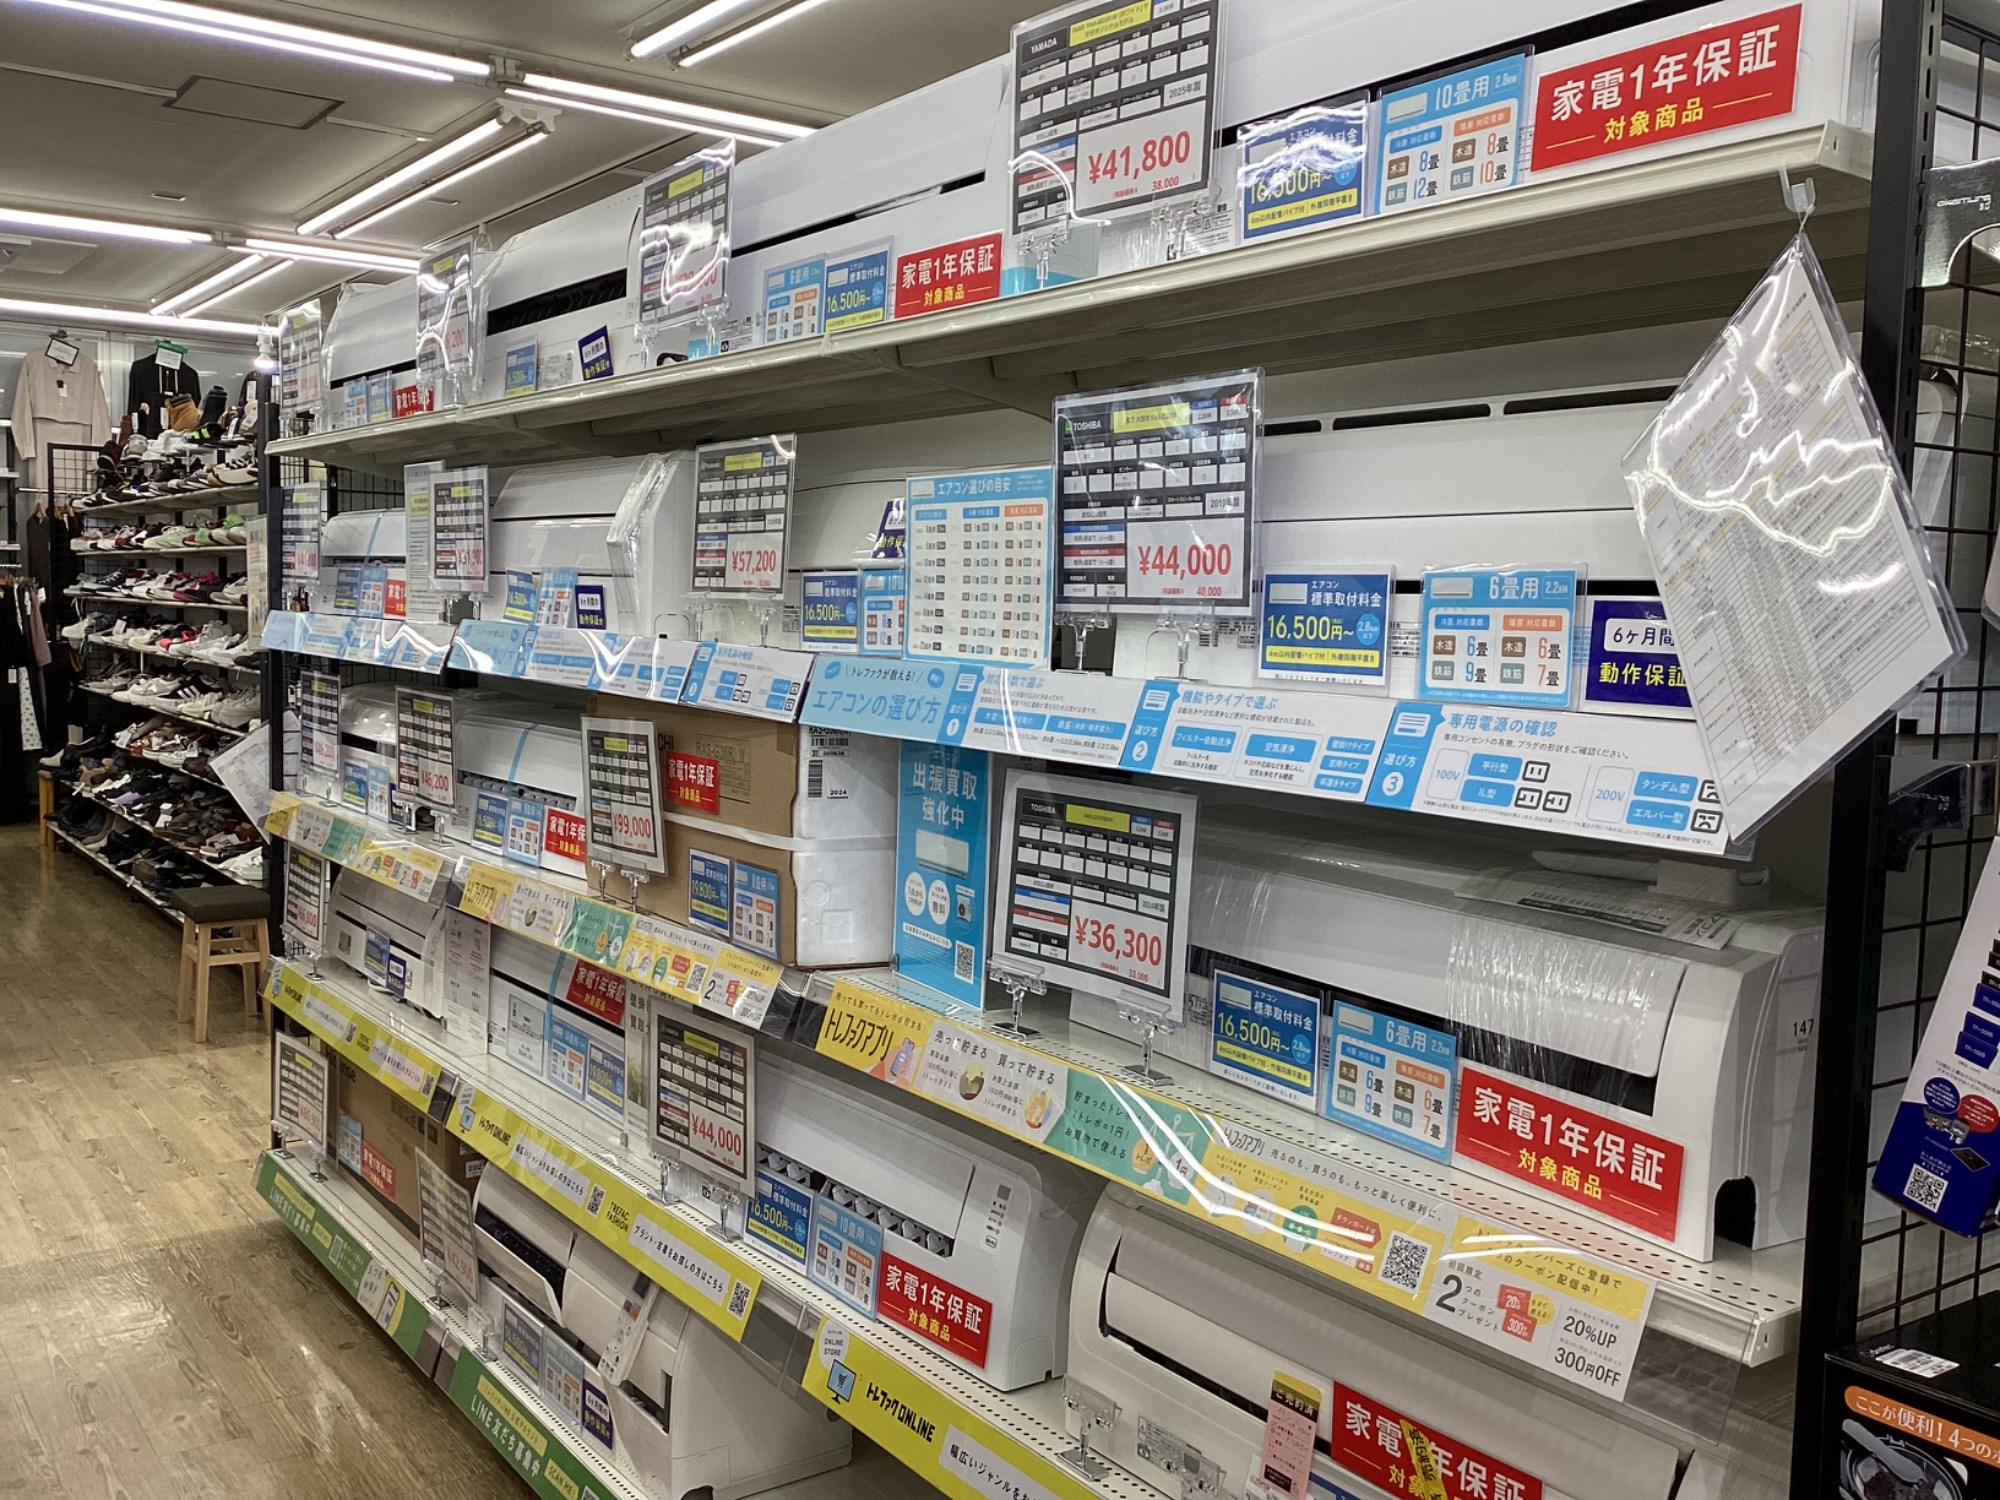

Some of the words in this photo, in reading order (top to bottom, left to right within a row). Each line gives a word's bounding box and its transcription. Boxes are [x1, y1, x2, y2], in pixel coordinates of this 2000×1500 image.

[1031, 37, 1057, 54] YAMADA
[1551, 24, 1781, 121] 家電1年保証
[1435, 75, 1490, 111] 10畳用
[1603, 97, 1704, 143] 対象商品
[1088, 131, 1191, 184] ¥41,800
[1454, 144, 1474, 159] 木造
[1486, 133, 1509, 155] 8畳
[1419, 151, 1440, 172] 8畳
[1479, 160, 1507, 184] 10畳
[1152, 176, 1180, 191] 38,000
[1413, 177, 1438, 200] 12畳
[902, 243, 995, 289] 家電1年保証
[923, 284, 965, 307] 対象商品
[1073, 420, 1102, 432] TOSHIBA
[937, 477, 1012, 496] エアコン選びの目安
[732, 550, 777, 575] ¥57,200
[1138, 543, 1232, 580] ¥44,000
[1311, 580, 1340, 589] エアコン
[1489, 576, 1539, 600] 6畳用
[1311, 592, 1381, 607] 標準取付料金
[1434, 639, 1454, 652] 木造
[1467, 635, 1488, 657] 6畳
[1503, 640, 1524, 654] 木造
[1538, 636, 1561, 659] 6畳
[986, 674, 1045, 688] 対応数で選ぶ
[1434, 664, 1453, 677] 鉄筋
[1466, 662, 1487, 683] 9畳
[1502, 667, 1523, 680] 鉄筋
[1538, 664, 1560, 687] 7畳
[1600, 662, 1687, 687] 動作保証
[812, 690, 942, 724] エアコンの選び方
[949, 704, 968, 715] 選び方
[1181, 690, 1278, 710] 機能やタイプで選ぶ
[1133, 725, 1158, 737] 選び方
[1448, 713, 1558, 737] 専用電源の確認
[1383, 753, 1418, 768] 選び方
[1481, 761, 1509, 774] 平行型
[668, 759, 715, 788] 家電1年保証
[913, 762, 977, 801] 出張買取
[1435, 768, 1461, 782] 100V
[1595, 788, 1625, 802] 200V
[1641, 778, 1691, 795] タンデム型
[922, 797, 965, 830] 強化中
[1030, 803, 1056, 814] TOSHIBA
[1632, 807, 1684, 824] エルバー型
[613, 813, 651, 838] ¥99,000
[1075, 915, 1162, 966] ¥36,300
[576, 967, 626, 1003] 家電1年保証
[704, 979, 716, 1000] 2
[1254, 991, 1278, 1003] エアコン
[1254, 1001, 1313, 1031] 標準取付料金
[1793, 1018, 1815, 1036] 147
[824, 1008, 894, 1062] トレファックアプリ
[1386, 1019, 1427, 1052] 6畳用
[997, 1053, 1055, 1085] 買って貯まる
[1340, 1065, 1357, 1080] 木造
[1366, 1070, 1384, 1094] 6畳
[1365, 1094, 1382, 1118] 9畳
[1396, 1085, 1413, 1101] 木造
[1424, 1090, 1443, 1115] 6畳
[691, 1113, 741, 1157] ¥44,000
[1423, 1115, 1441, 1140] 7畳
[1473, 1086, 1666, 1191] 家電1年保証
[467, 1162, 482, 1172] 202
[1518, 1148, 1602, 1200] 対象商品
[606, 1211, 630, 1233] FASHION
[610, 1201, 629, 1221] TREFAC
[1448, 1260, 1483, 1280] 初回限定
[886, 1265, 983, 1335] 家電1年保証
[1436, 1275, 1462, 1314] 2
[1465, 1285, 1481, 1297] つの
[1462, 1297, 1495, 1315] クーポン
[907, 1307, 950, 1343] 対象商品
[1459, 1309, 1499, 1332] プレゼント
[1563, 1315, 1617, 1348] 20%UP
[823, 1346, 841, 1356] STORE
[824, 1337, 844, 1347] ONLINE
[1554, 1346, 1622, 1388] 300円OFF
[1345, 1400, 1526, 1500] 家電年保証
